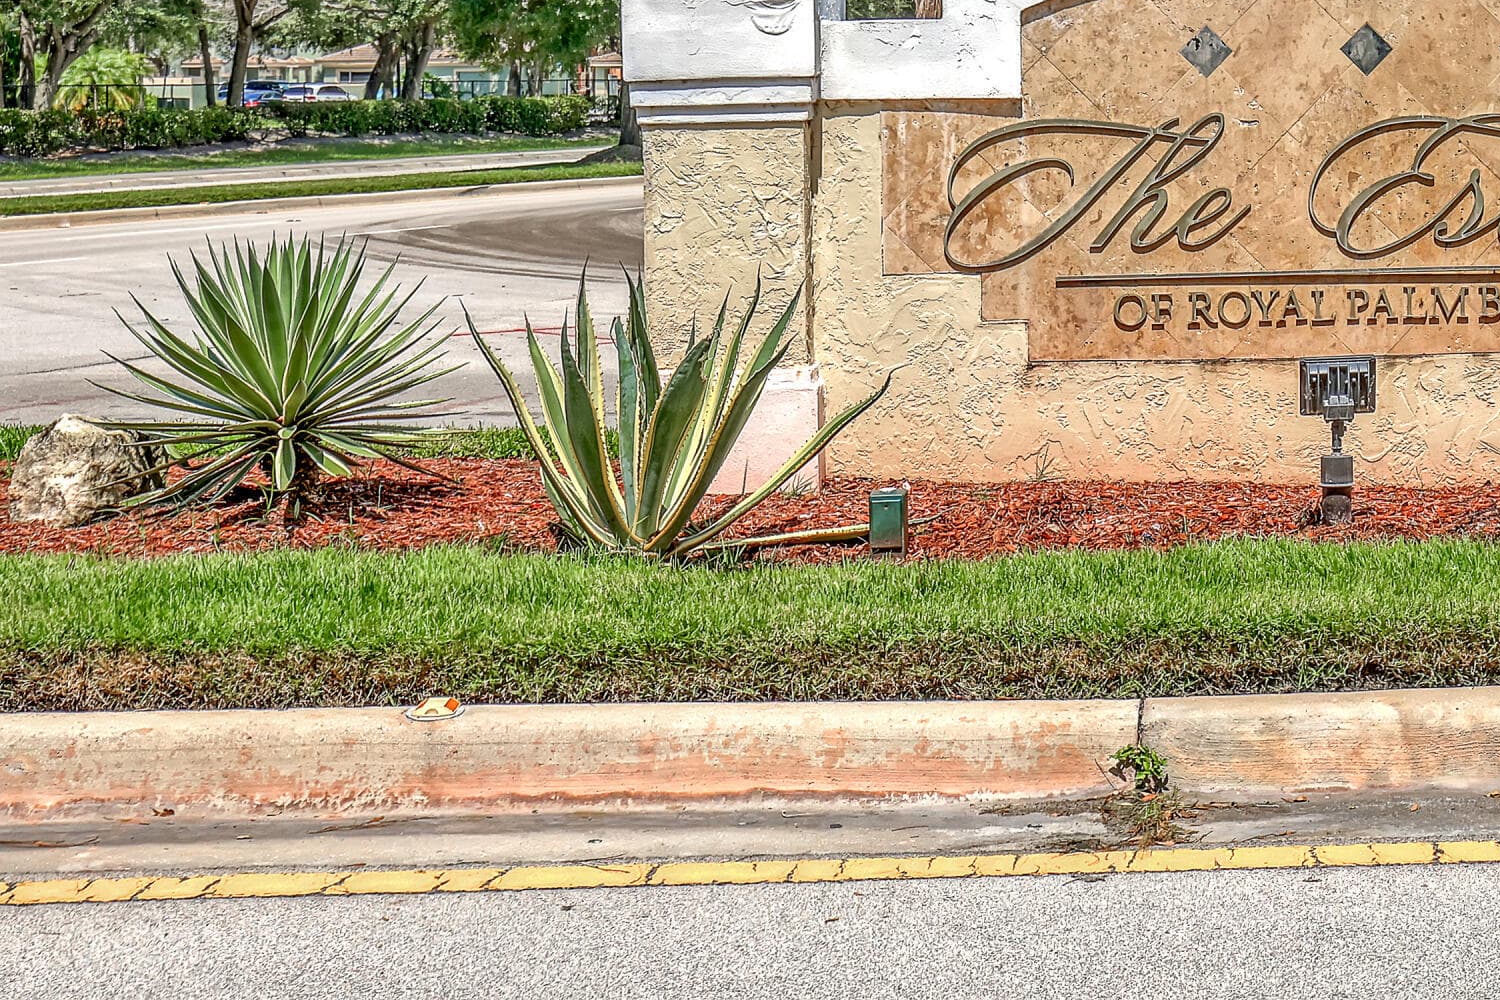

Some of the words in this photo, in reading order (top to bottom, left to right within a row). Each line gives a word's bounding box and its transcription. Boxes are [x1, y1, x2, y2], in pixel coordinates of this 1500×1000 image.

[944, 111, 1252, 272] The
[1112, 292, 1173, 331] OF
[1187, 289, 1336, 329] ROYAL
[1346, 286, 1468, 326] PALM
